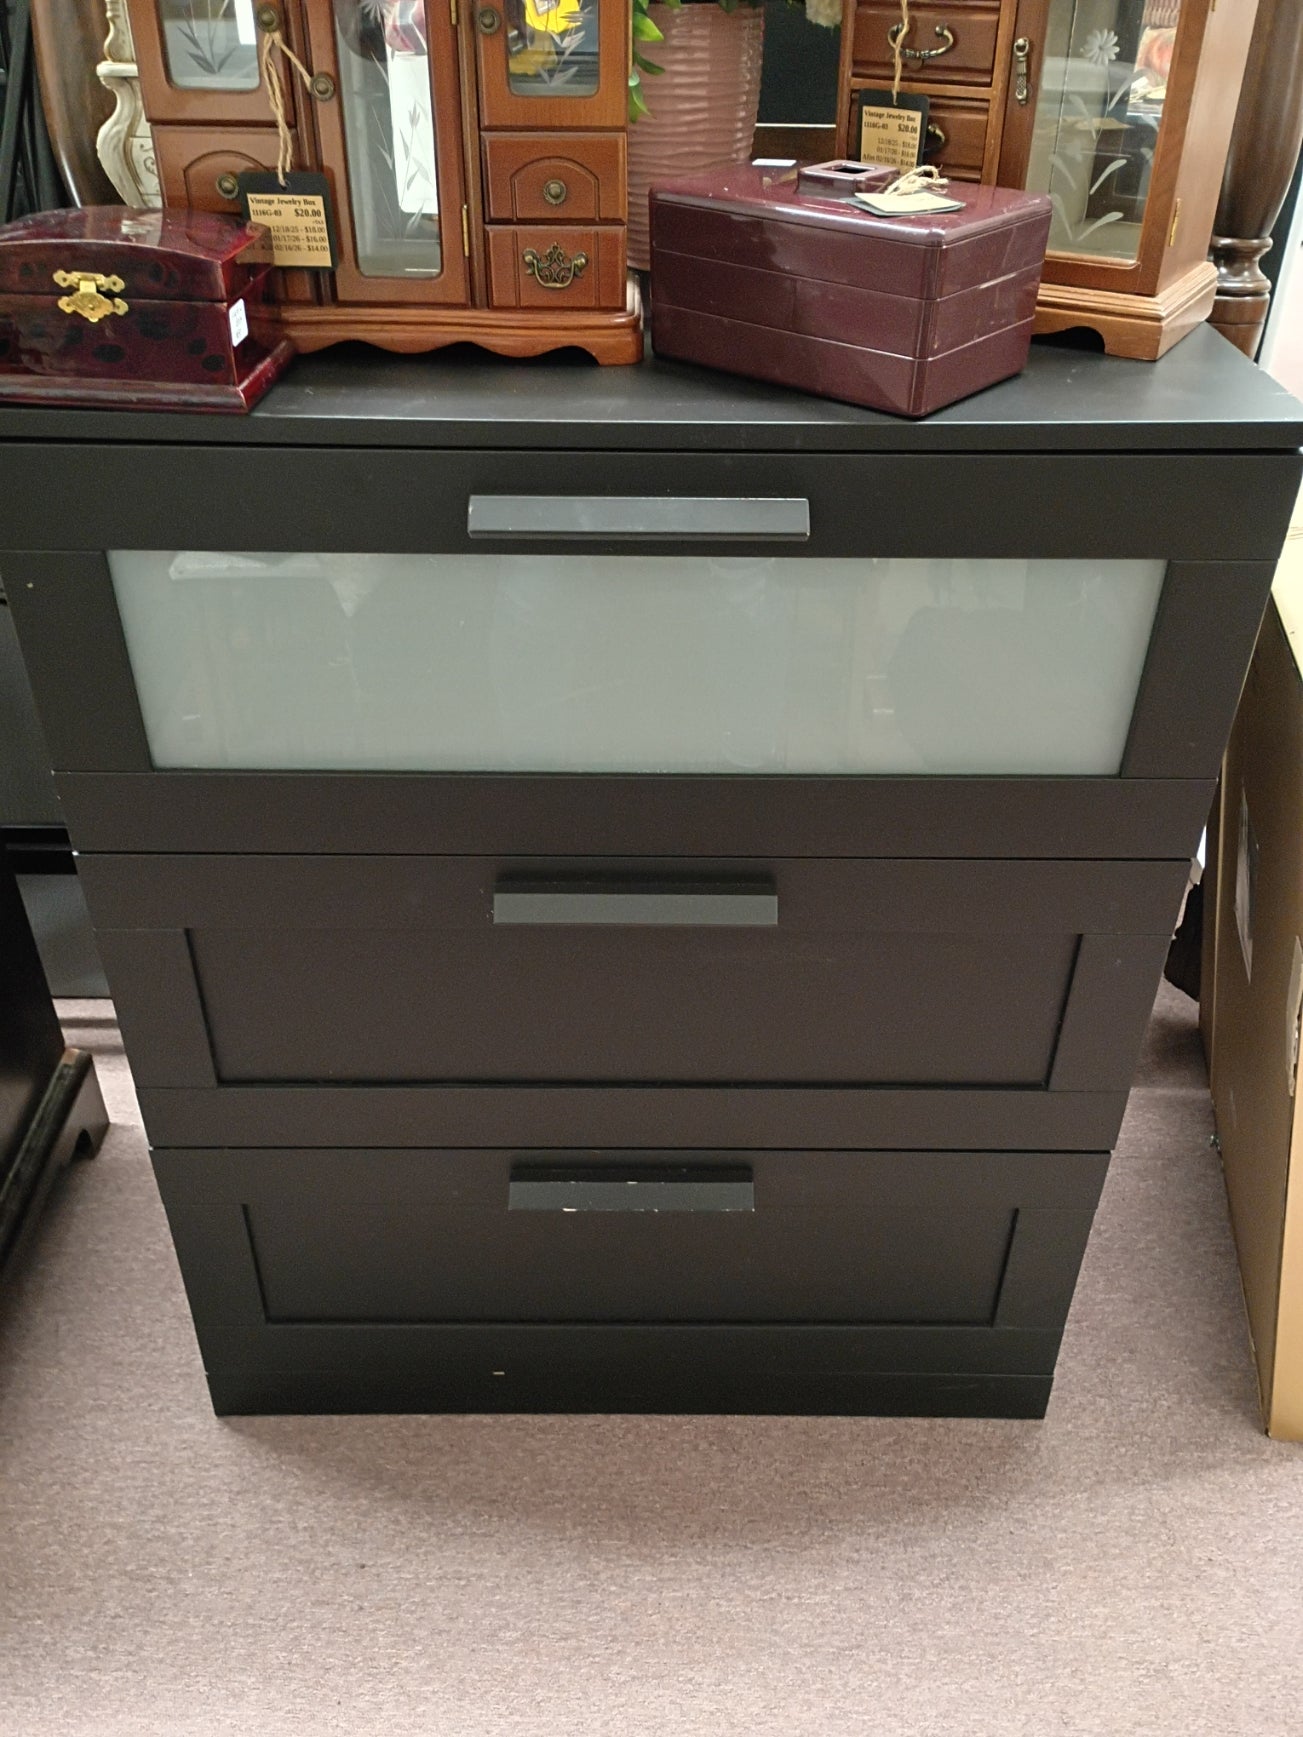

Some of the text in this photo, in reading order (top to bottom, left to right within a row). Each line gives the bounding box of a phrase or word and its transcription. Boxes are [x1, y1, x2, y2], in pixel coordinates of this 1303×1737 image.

[865, 110, 884, 119] Vintage
[887, 113, 905, 122] Jewelry
[898, 124, 917, 133] $20.00
[278, 198, 301, 206] Jewelry
[294, 208, 321, 217] $20.00
